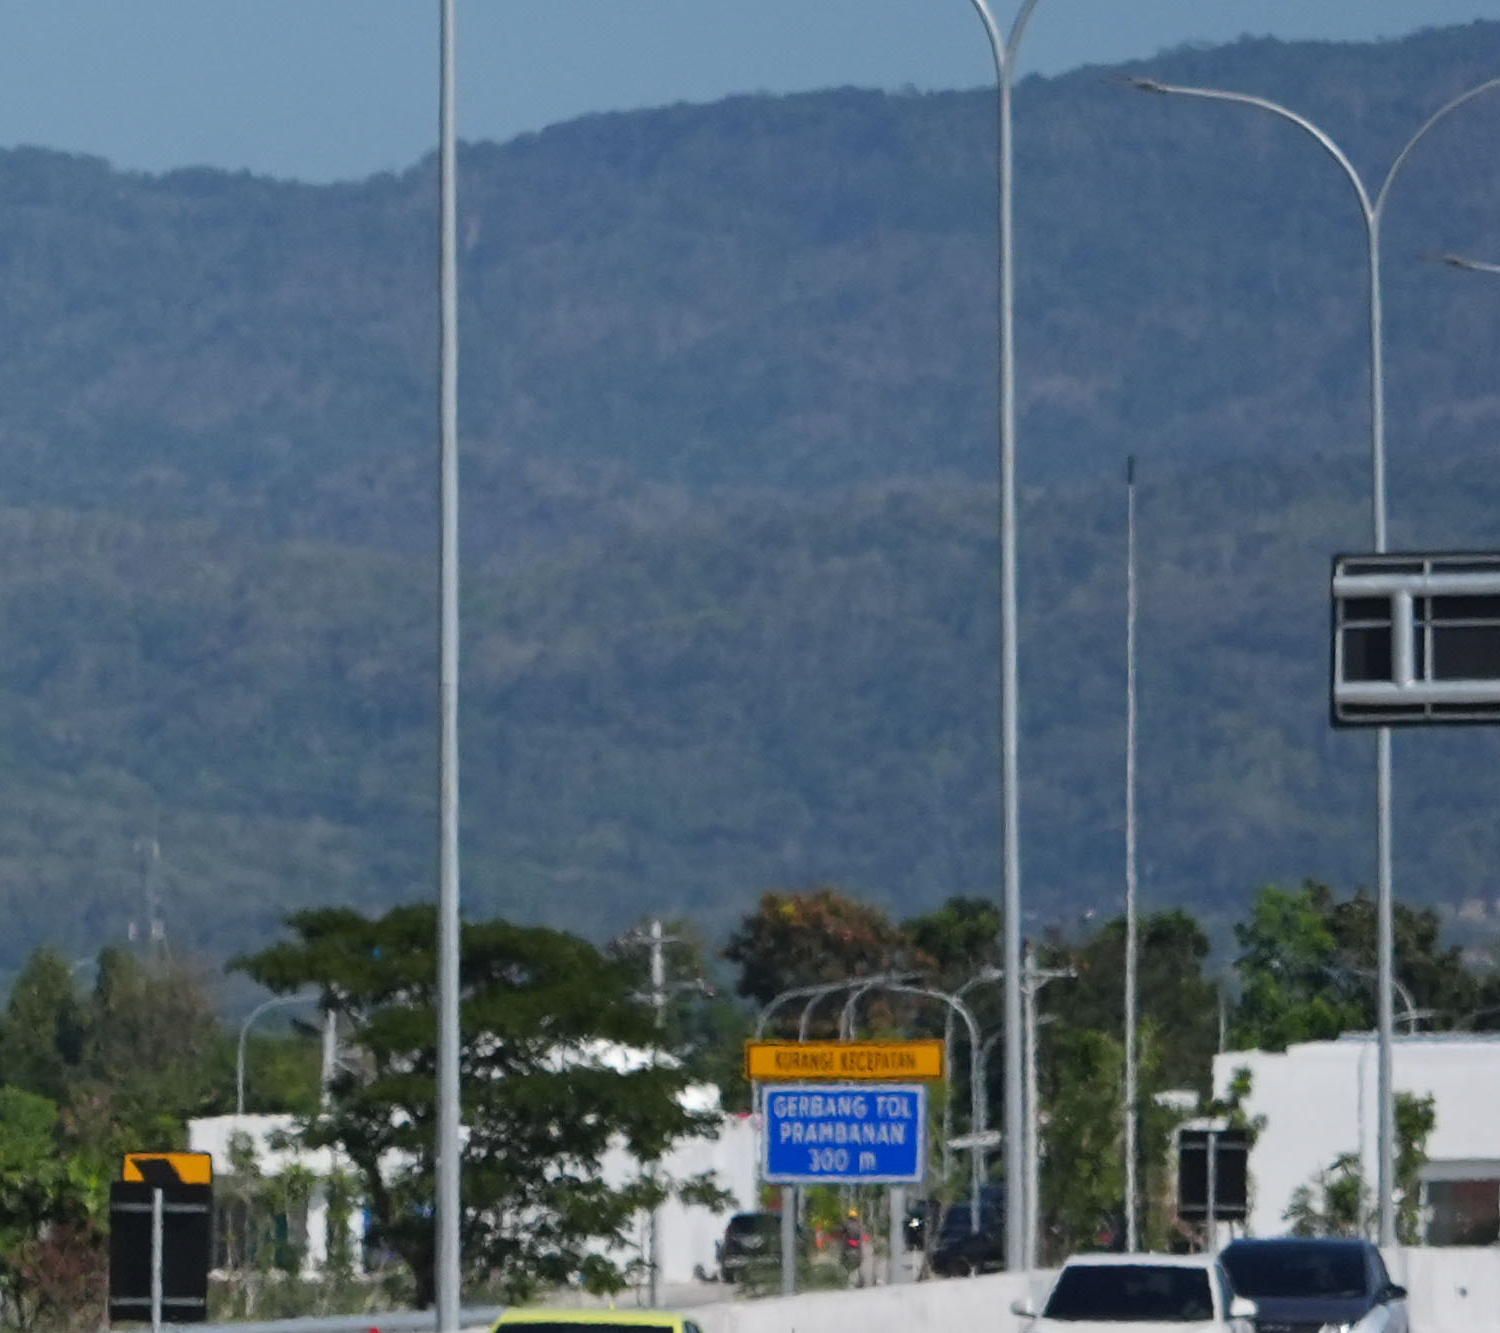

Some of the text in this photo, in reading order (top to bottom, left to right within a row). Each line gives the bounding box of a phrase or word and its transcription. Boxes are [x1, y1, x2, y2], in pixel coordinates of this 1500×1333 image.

[773, 1095, 913, 1119] GERBANG TOL
[780, 1122, 906, 1145] PRAMBANAN
[809, 1148, 877, 1172] 300 m
